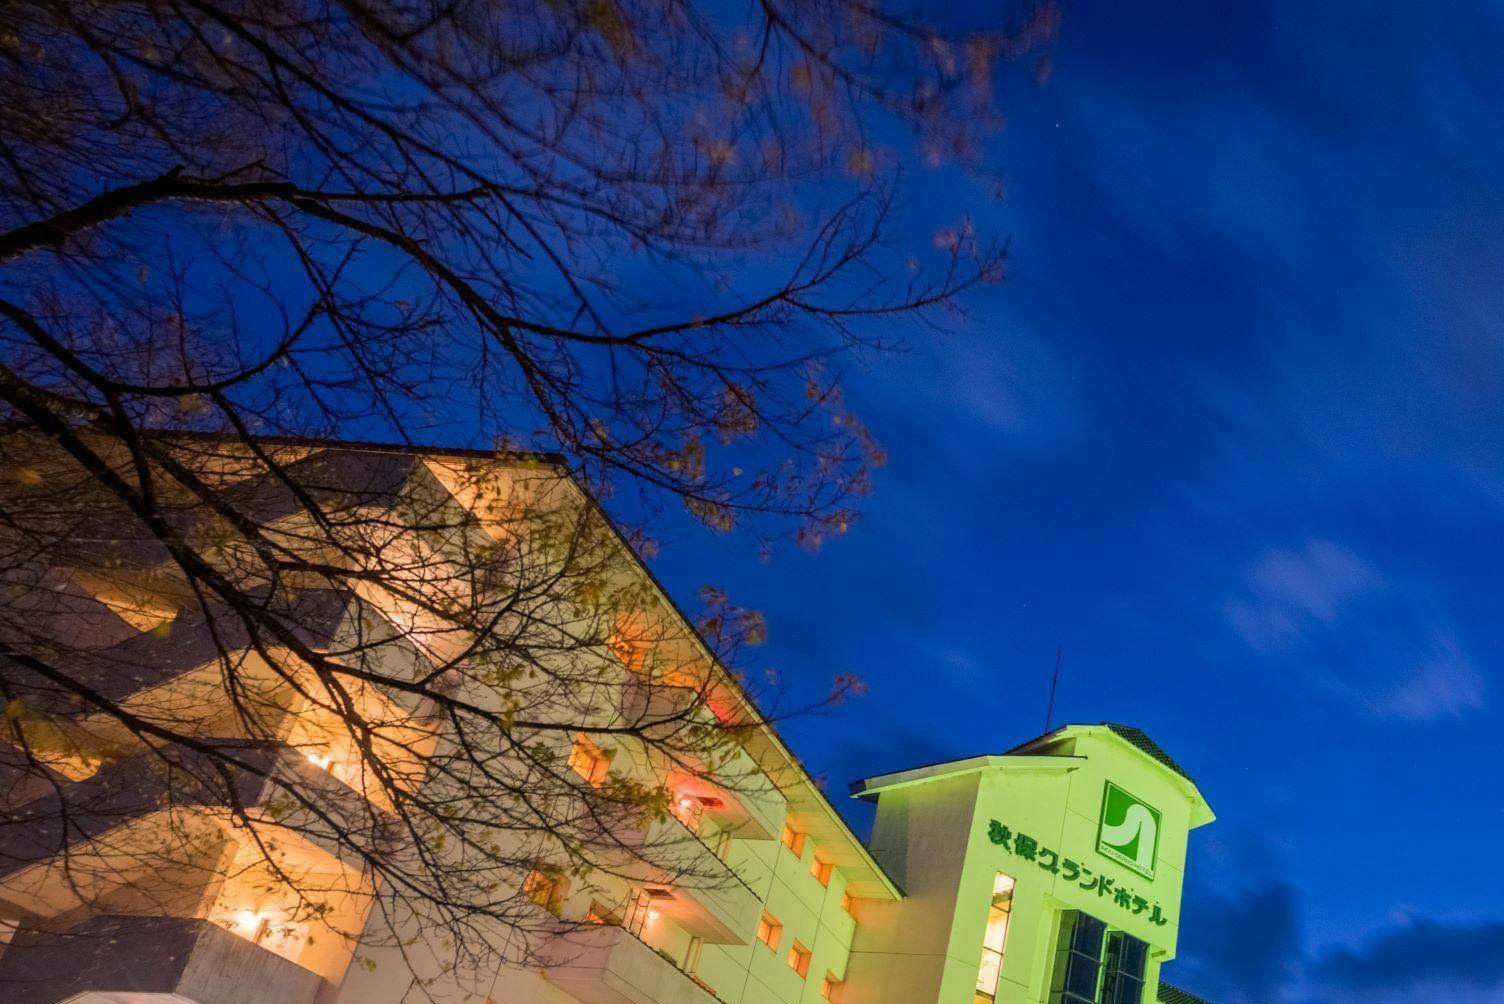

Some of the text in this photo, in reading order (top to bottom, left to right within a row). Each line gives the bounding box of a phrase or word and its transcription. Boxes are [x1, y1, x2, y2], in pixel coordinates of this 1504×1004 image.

[988, 819, 1167, 926] 秋保グランドホテル
